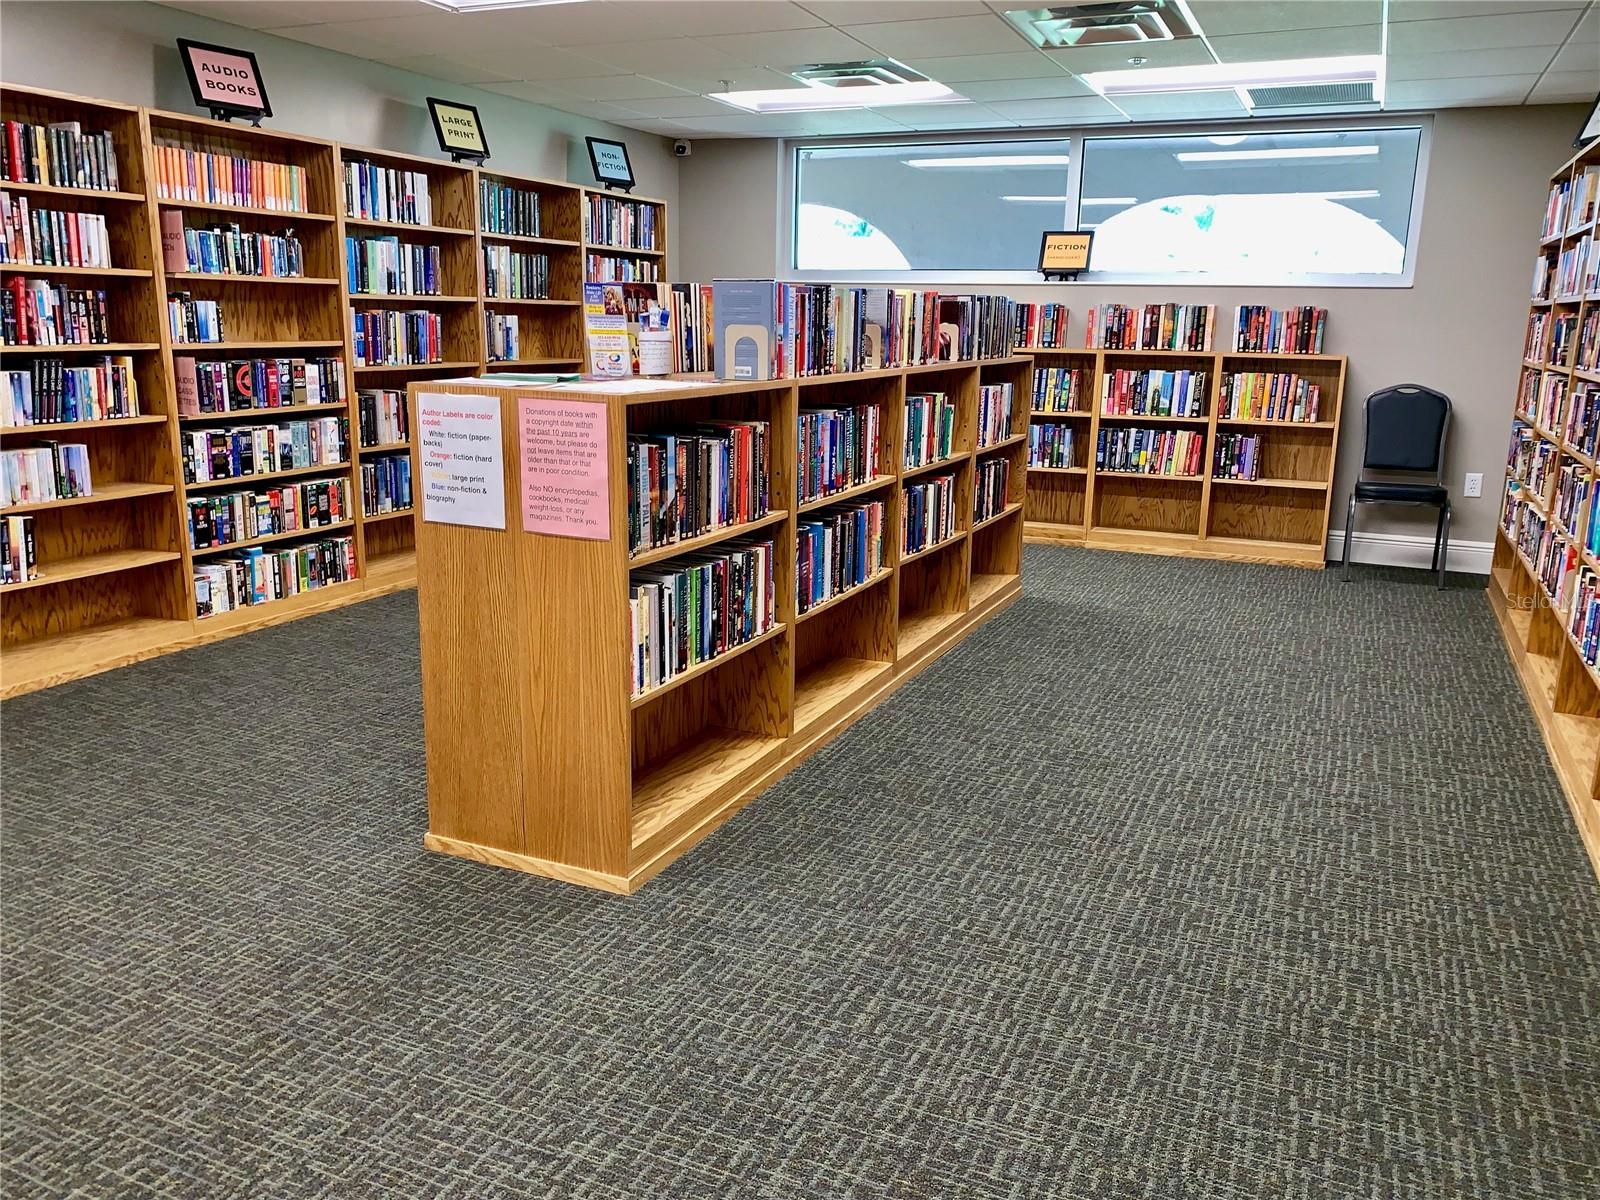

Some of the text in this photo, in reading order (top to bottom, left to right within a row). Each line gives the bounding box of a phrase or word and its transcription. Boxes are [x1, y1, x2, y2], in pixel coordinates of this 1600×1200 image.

[201, 63, 248, 79] AUDIO
[205, 80, 256, 96] BOOKS
[441, 115, 473, 127] LARGE
[447, 129, 474, 140] PRINT
[601, 152, 620, 160] NON-
[597, 162, 627, 171] FICTION
[422, 409, 441, 417] Author
[442, 411, 464, 419] Labels
[477, 412, 494, 420] color
[525, 407, 556, 417] Donations
[557, 409, 564, 417] of
[564, 410, 584, 418] books
[531, 418, 559, 428] copyright
[575, 421, 594, 429] within
[428, 430, 492, 442] White: fiction (paper-
[526, 427, 536, 435] the
[537, 428, 551, 436] past
[423, 439, 443, 448] backs)
[526, 438, 555, 446] welcome,
[567, 440, 588, 448] please
[430, 451, 493, 463] Orange: fiction (hard
[537, 447, 555, 455] leave
[555, 448, 573, 456] items
[573, 449, 585, 457] that
[424, 461, 443, 469] cover)
[543, 457, 558, 465] than
[558, 458, 571, 466] that
[545, 467, 560, 475] poor
[561, 468, 591, 477] condition.
[452, 474, 468, 483] large
[469, 475, 485, 484] print
[431, 482, 446, 491] Blue:
[447, 486, 481, 494] non-fiction
[528, 484, 600, 498] Also NO encyclopedias,
[426, 493, 456, 504] biography
[528, 494, 590, 506] cookbooks, medical/
[529, 504, 565, 513] weight-loss,
[565, 516, 584, 524] Thank
[642, 504, 650, 527] FALL
